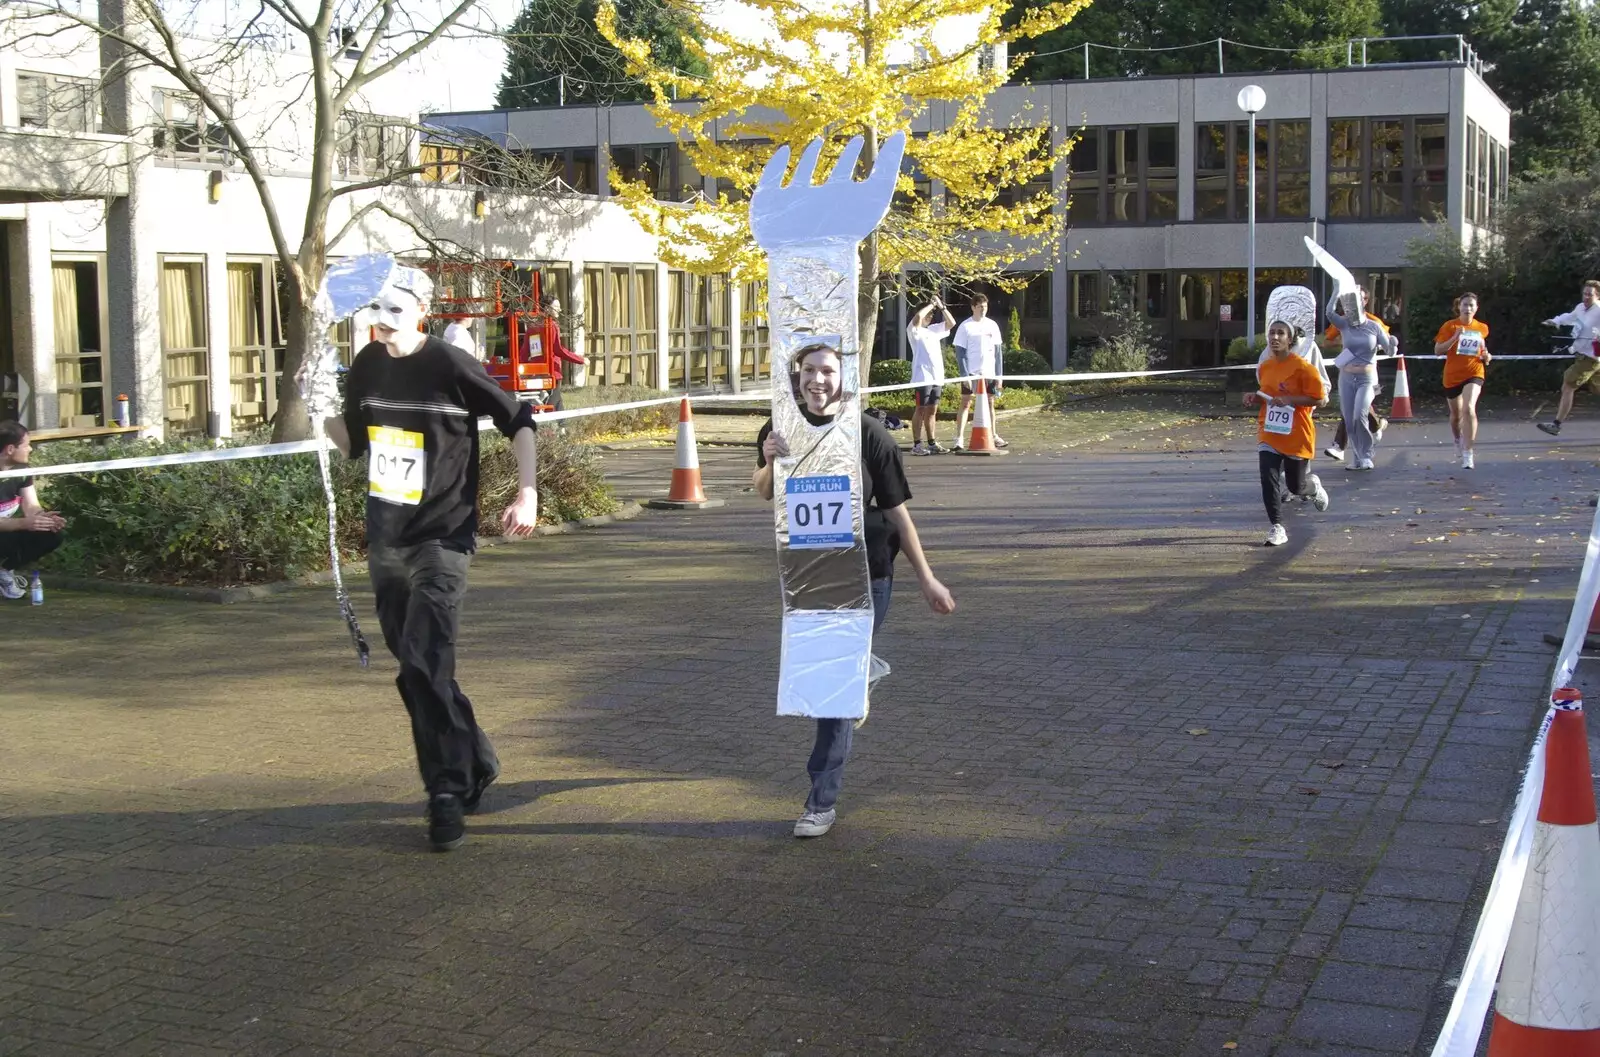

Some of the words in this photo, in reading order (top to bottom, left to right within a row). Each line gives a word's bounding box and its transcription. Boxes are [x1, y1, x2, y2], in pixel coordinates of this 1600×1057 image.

[1460, 338, 1478, 348] 074
[1268, 410, 1290, 424] 079
[377, 453, 416, 481] 017
[794, 483, 816, 492] FUN
[820, 482, 842, 491] RUN
[794, 501, 844, 527] 017
